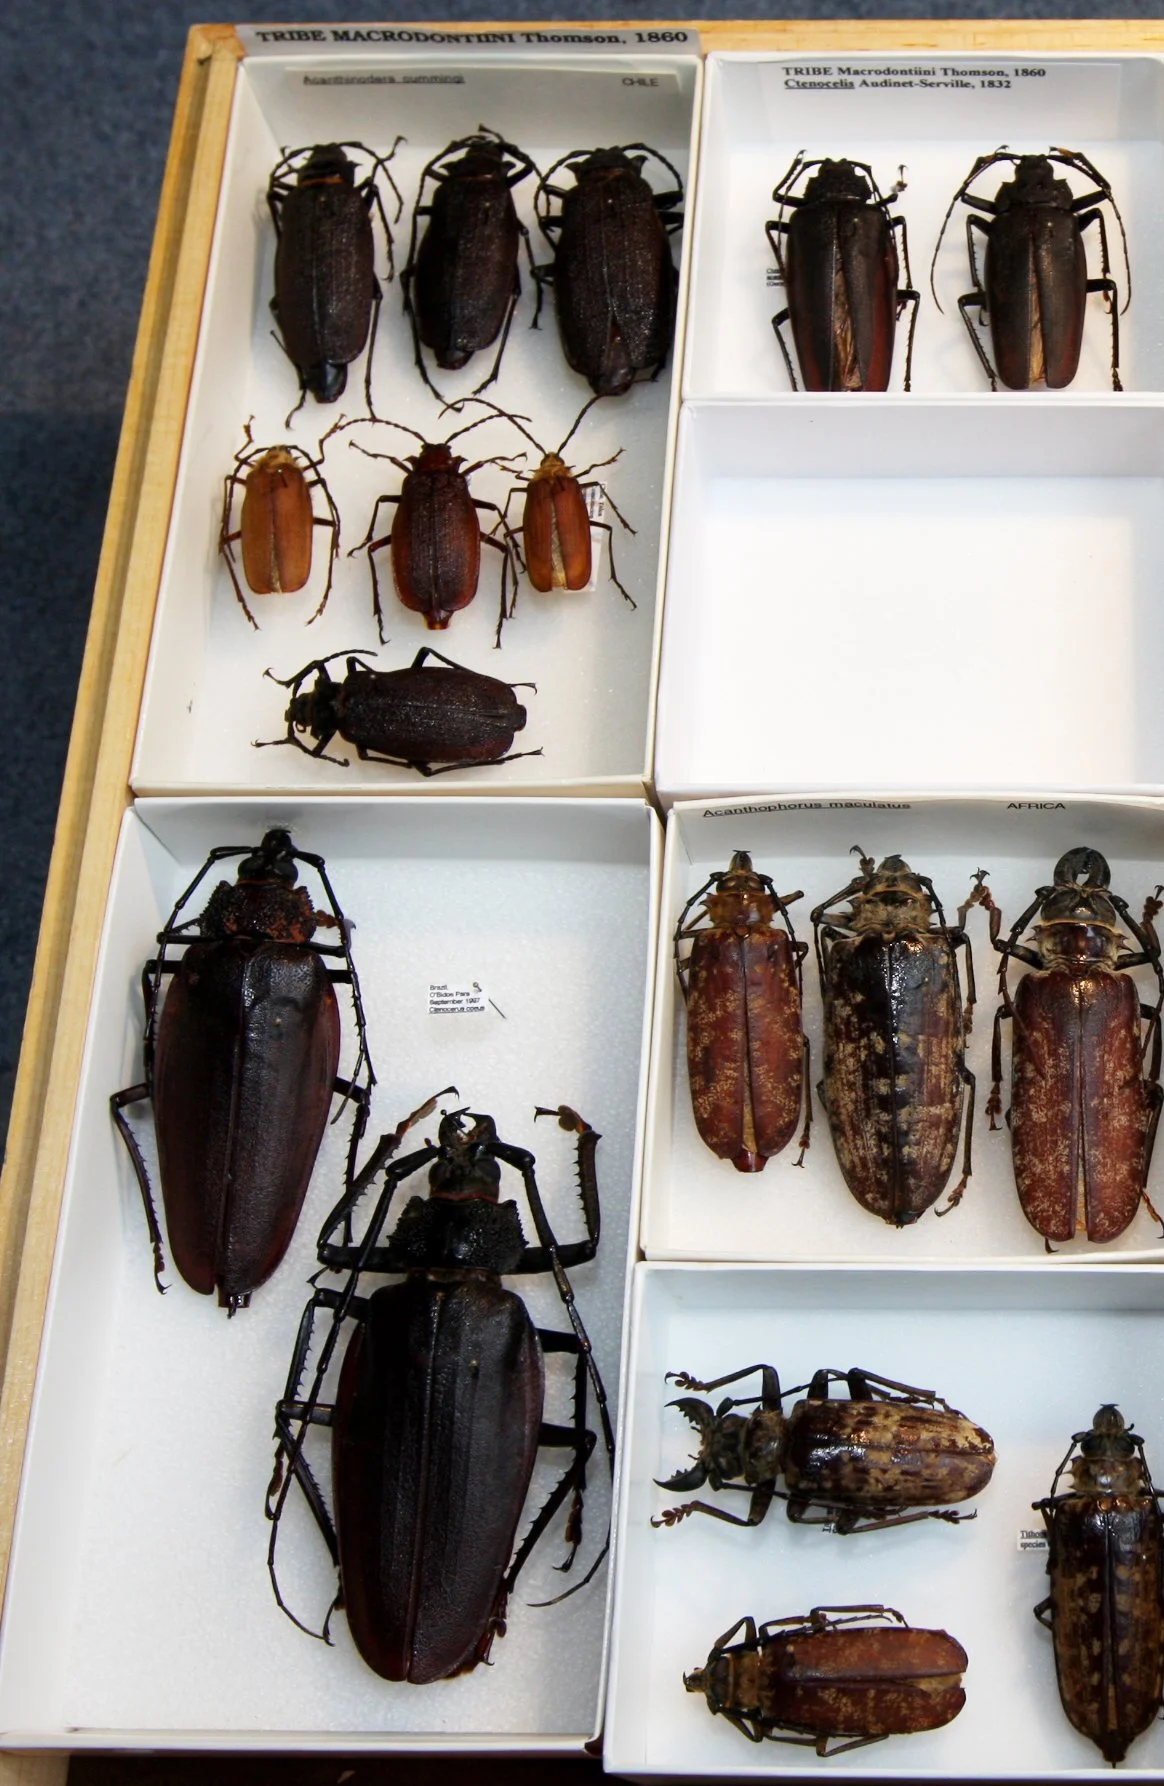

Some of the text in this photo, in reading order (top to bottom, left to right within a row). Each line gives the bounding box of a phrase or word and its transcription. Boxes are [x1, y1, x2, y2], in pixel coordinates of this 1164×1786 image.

[256, 29, 688, 45] TRIBE MACRODONTIINI Thomson, 1860
[783, 67, 1046, 77] TRIBE Macrodontiini Thomson, 1860
[622, 77, 660, 88] CHILE
[785, 78, 1012, 90] Ctenocelis Audinet-Serville, 1832
[702, 801, 911, 818] Acanthophorus maculatus
[1006, 801, 1066, 810] AFRICA
